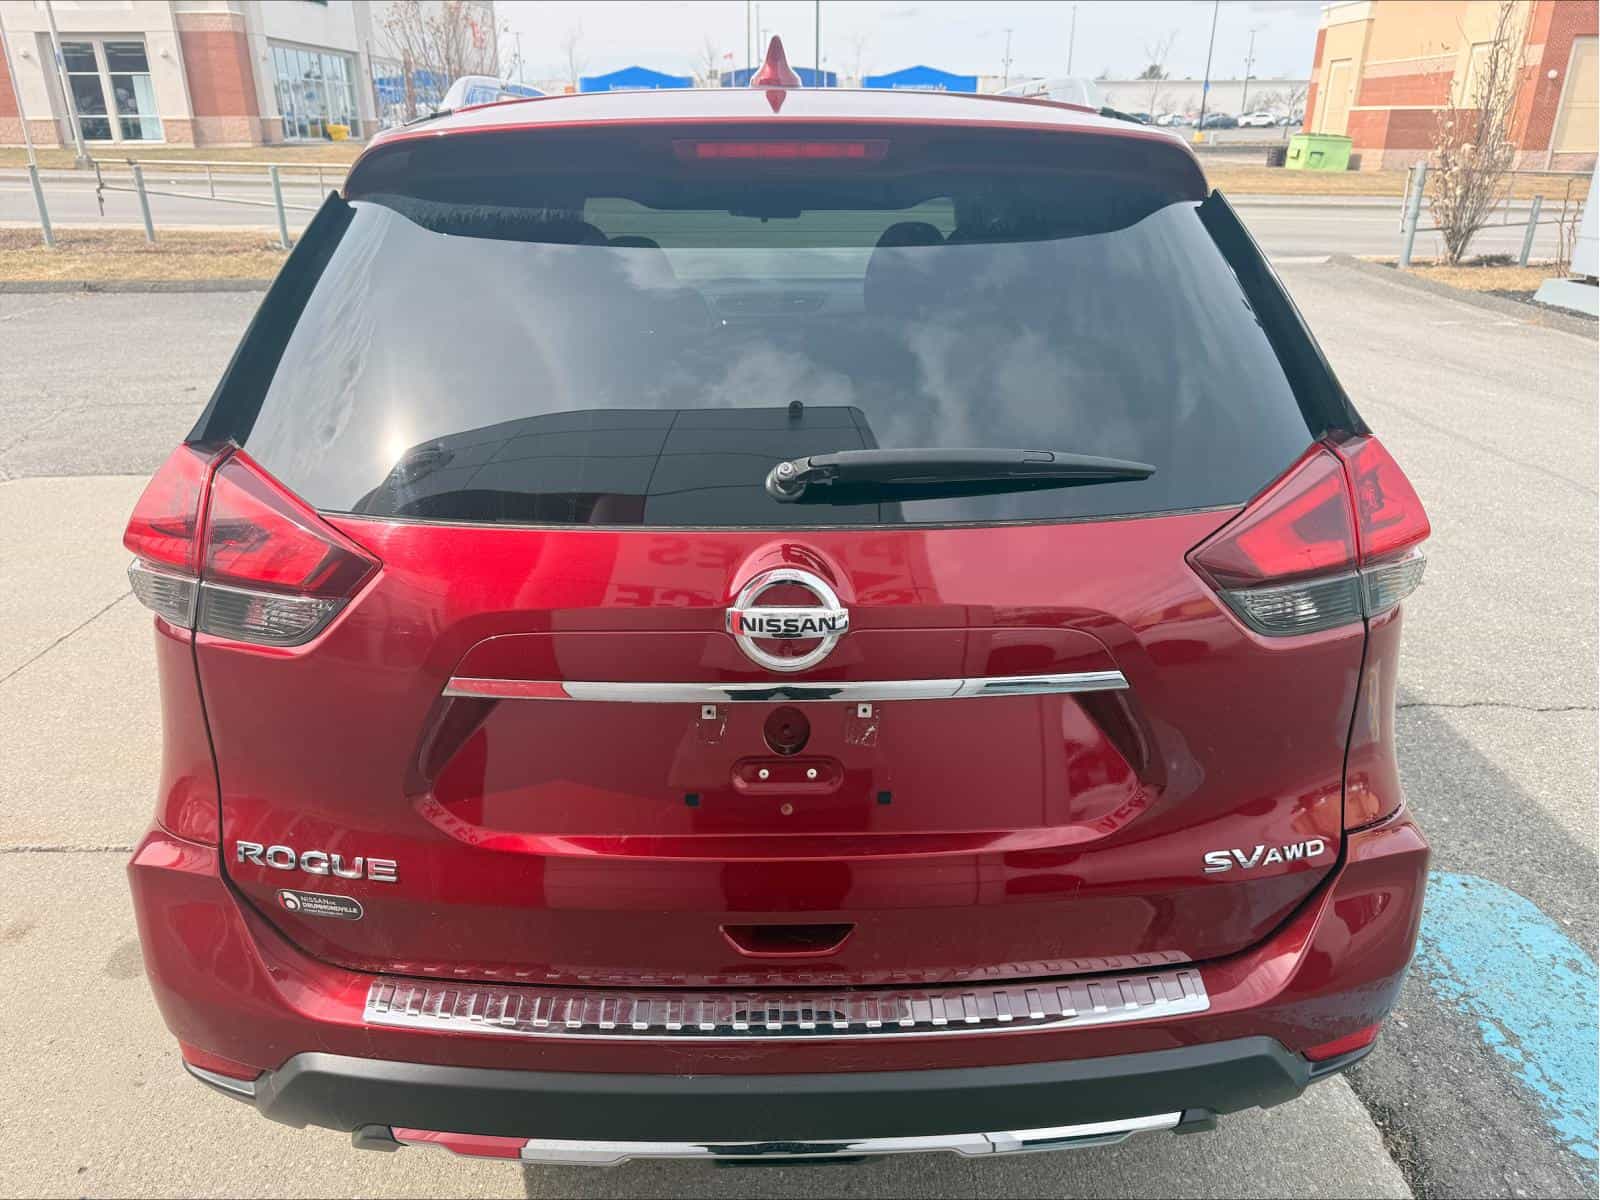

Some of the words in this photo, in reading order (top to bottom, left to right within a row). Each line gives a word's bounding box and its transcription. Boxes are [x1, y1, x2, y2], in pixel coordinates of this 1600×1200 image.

[739, 616, 836, 632] NISSAN
[236, 840, 397, 882] ROGUE
[1203, 844, 1264, 874] SV
[1263, 839, 1326, 866] AWD
